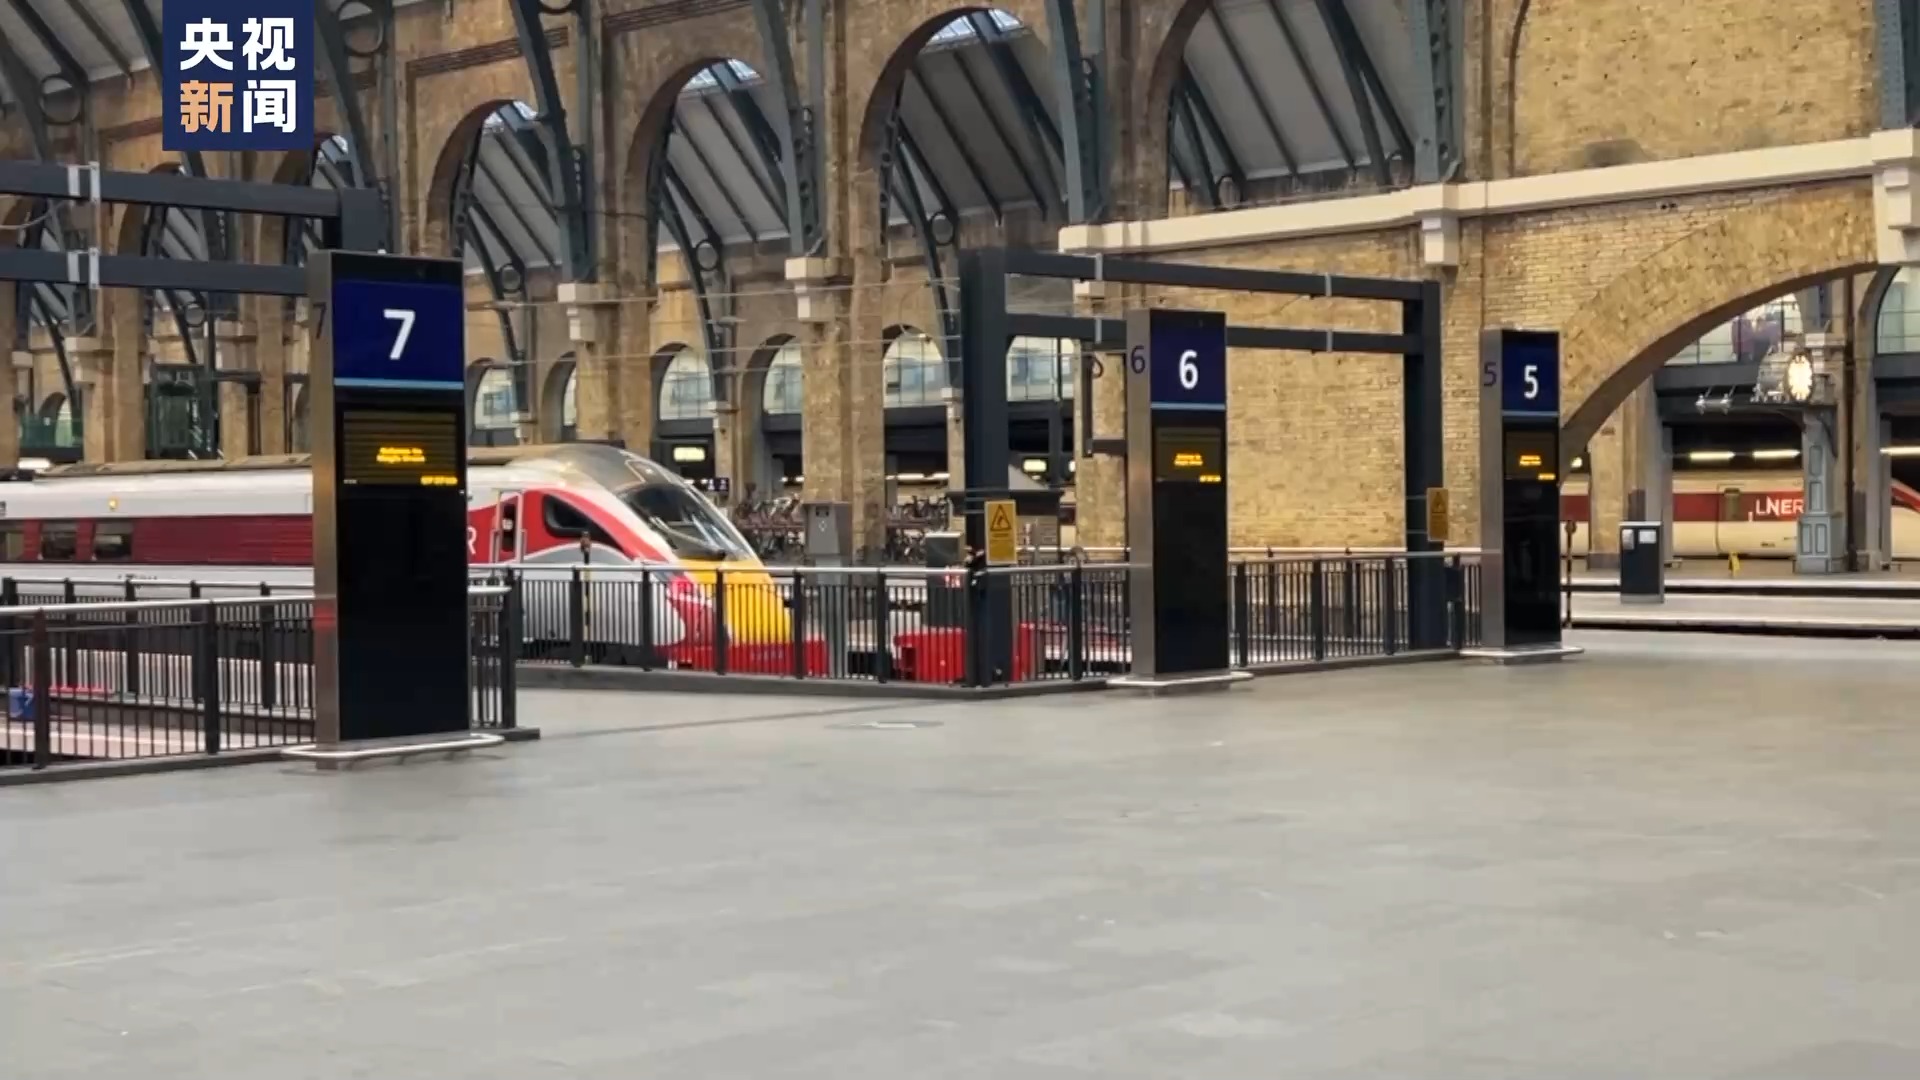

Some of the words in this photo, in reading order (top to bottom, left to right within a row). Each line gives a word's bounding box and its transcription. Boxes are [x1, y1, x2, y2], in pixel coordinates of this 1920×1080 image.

[312, 302, 327, 340] 7
[383, 308, 416, 360] 7
[1130, 345, 1146, 374] 6
[1179, 349, 1199, 389] 6
[1483, 362, 1497, 387] 5
[1523, 365, 1539, 399] 5
[1755, 497, 1804, 516] LNER
